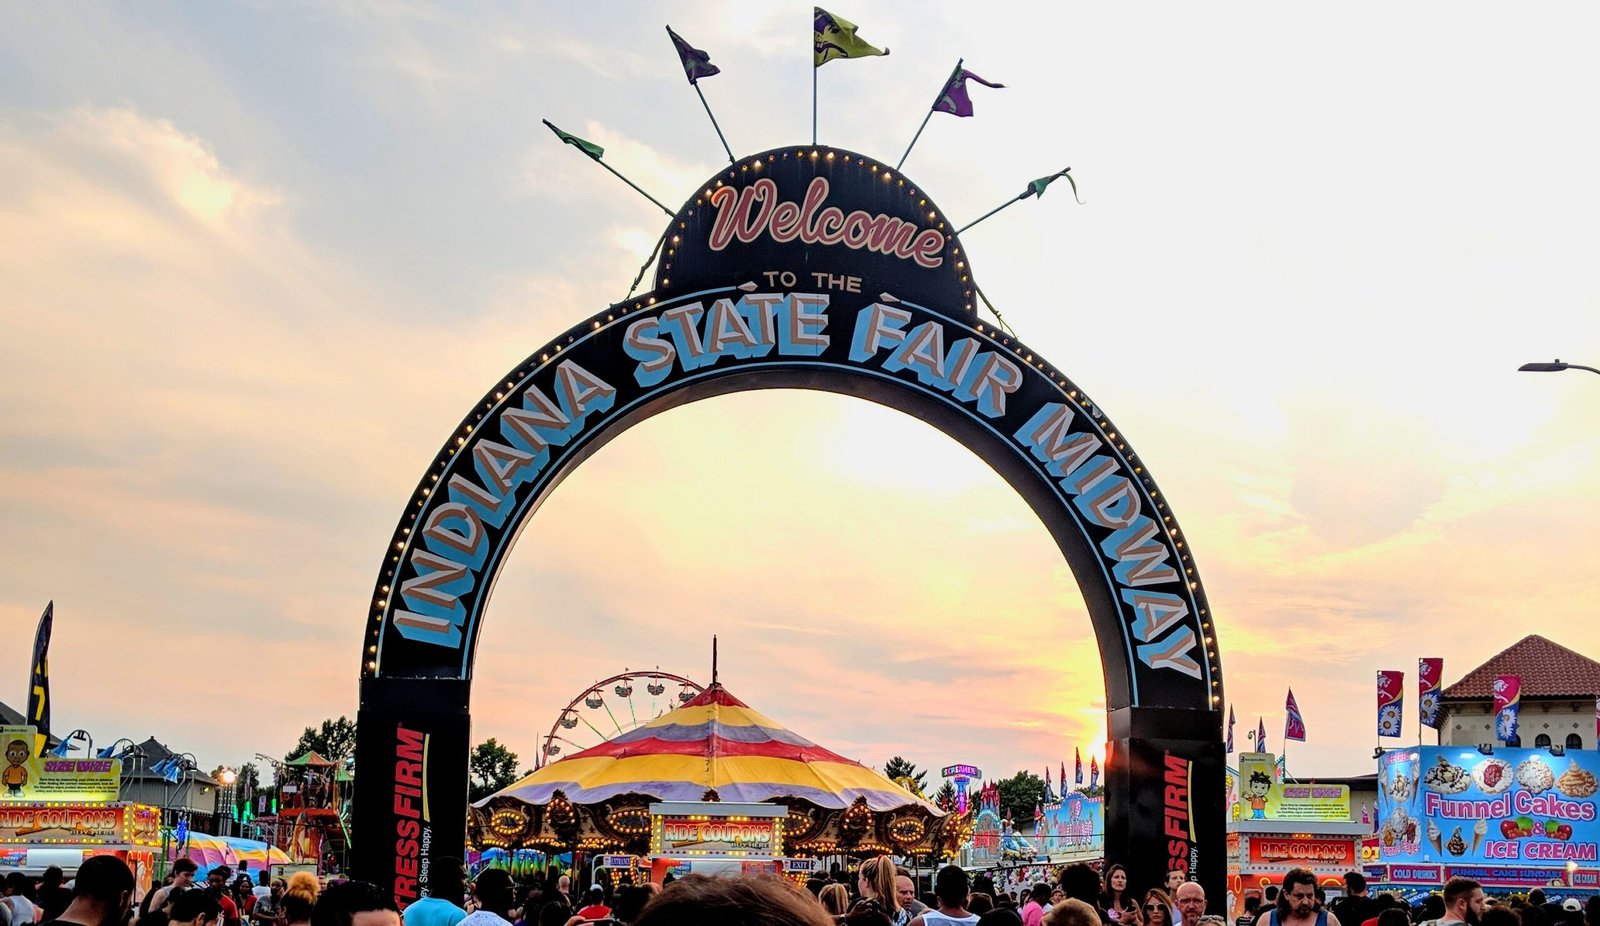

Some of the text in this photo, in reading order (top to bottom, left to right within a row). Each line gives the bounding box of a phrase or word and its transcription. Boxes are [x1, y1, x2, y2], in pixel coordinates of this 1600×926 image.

[709, 176, 946, 269] Welcome
[763, 271, 862, 293] TO THE
[393, 292, 1202, 680] INDIANA STATE FAIR MIDWAY
[1425, 790, 1596, 821] Funnel Cakes
[0, 810, 34, 829] RIDE
[38, 809, 117, 830] COUPONS
[1531, 821, 1545, 836] &
[420, 826, 433, 857] Happy.
[664, 822, 771, 843] RIDE COUPONS
[1189, 846, 1199, 874] Happy.
[1260, 842, 1288, 859] RIDE
[1290, 842, 1347, 861] COUPONS
[1485, 841, 1597, 860] ICE CREAM
[419, 858, 429, 883] Sleep
[791, 861, 808, 869] EXIT
[1393, 869, 1411, 879] COLD
[1412, 870, 1438, 880] DRINKS
[1450, 868, 1489, 876] FUNNEL
[1492, 869, 1517, 877] CAKE
[1573, 874, 1582, 883] ICE
